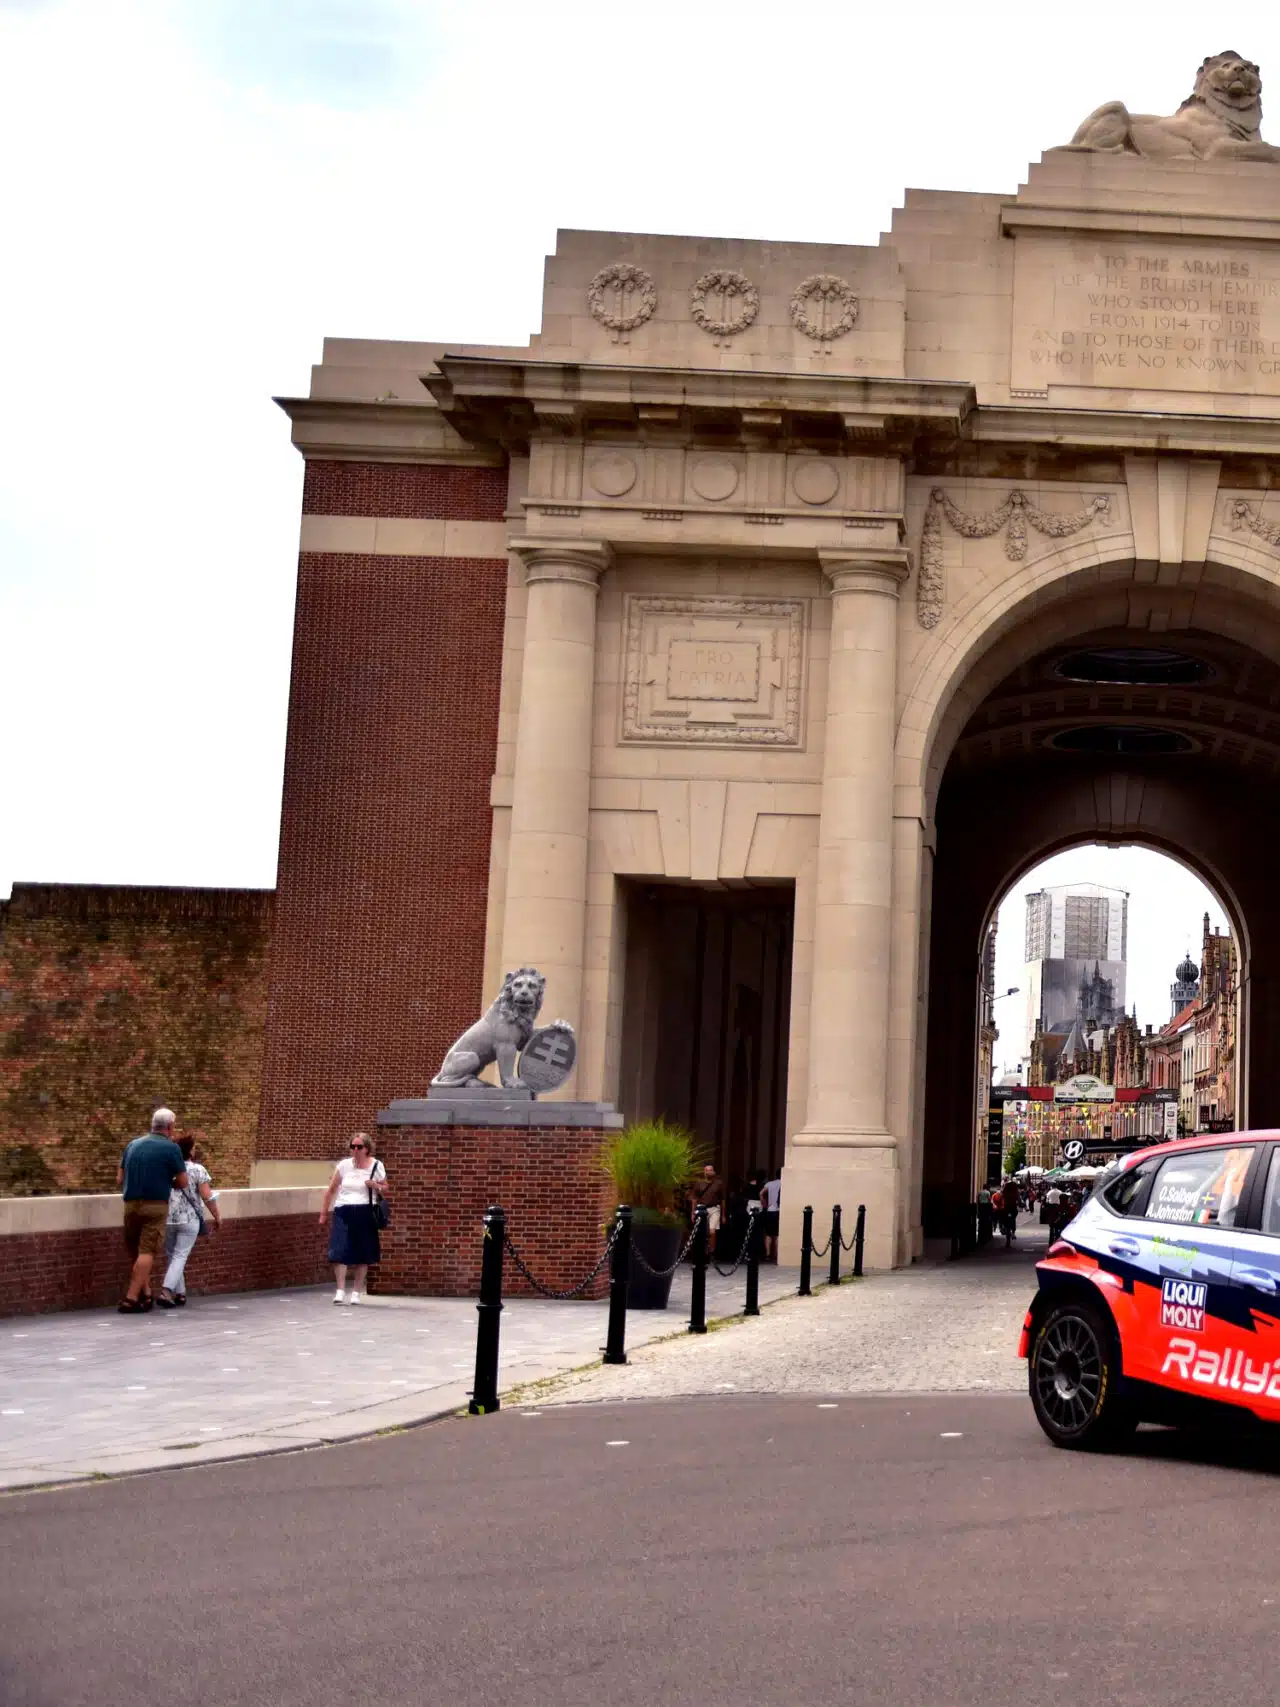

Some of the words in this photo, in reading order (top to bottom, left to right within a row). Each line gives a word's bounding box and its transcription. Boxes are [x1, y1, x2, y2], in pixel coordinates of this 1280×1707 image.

[1104, 255, 1126, 269] TO
[1136, 256, 1169, 273] THE
[1182, 259, 1250, 277] ARMIES
[1060, 274, 1086, 287] OF
[1094, 275, 1129, 290] THE
[1139, 278, 1213, 294] BRITISH
[1087, 293, 1132, 309] WHO
[1139, 296, 1200, 313] STOOD
[1209, 300, 1259, 316] HERE
[1089, 314, 1145, 329] FROM
[1153, 315, 1190, 331] 1914
[1199, 318, 1221, 333] TO
[1228, 319, 1260, 335] 1918
[1032, 331, 1075, 346] AND
[1083, 332, 1107, 347] TO
[1116, 334, 1174, 350] THOSE
[1183, 336, 1205, 352] OF
[1213, 338, 1265, 355] THEIR
[1030, 350, 1074, 365] WHO
[1081, 351, 1127, 368] HAVE
[1137, 354, 1166, 369] NO
[1176, 356, 1248, 373] KNOWN
[1145, 1203, 1194, 1222] A.Johnston
[1163, 1281, 1204, 1304] LIQUI
[1162, 1304, 1203, 1330] MOLY
